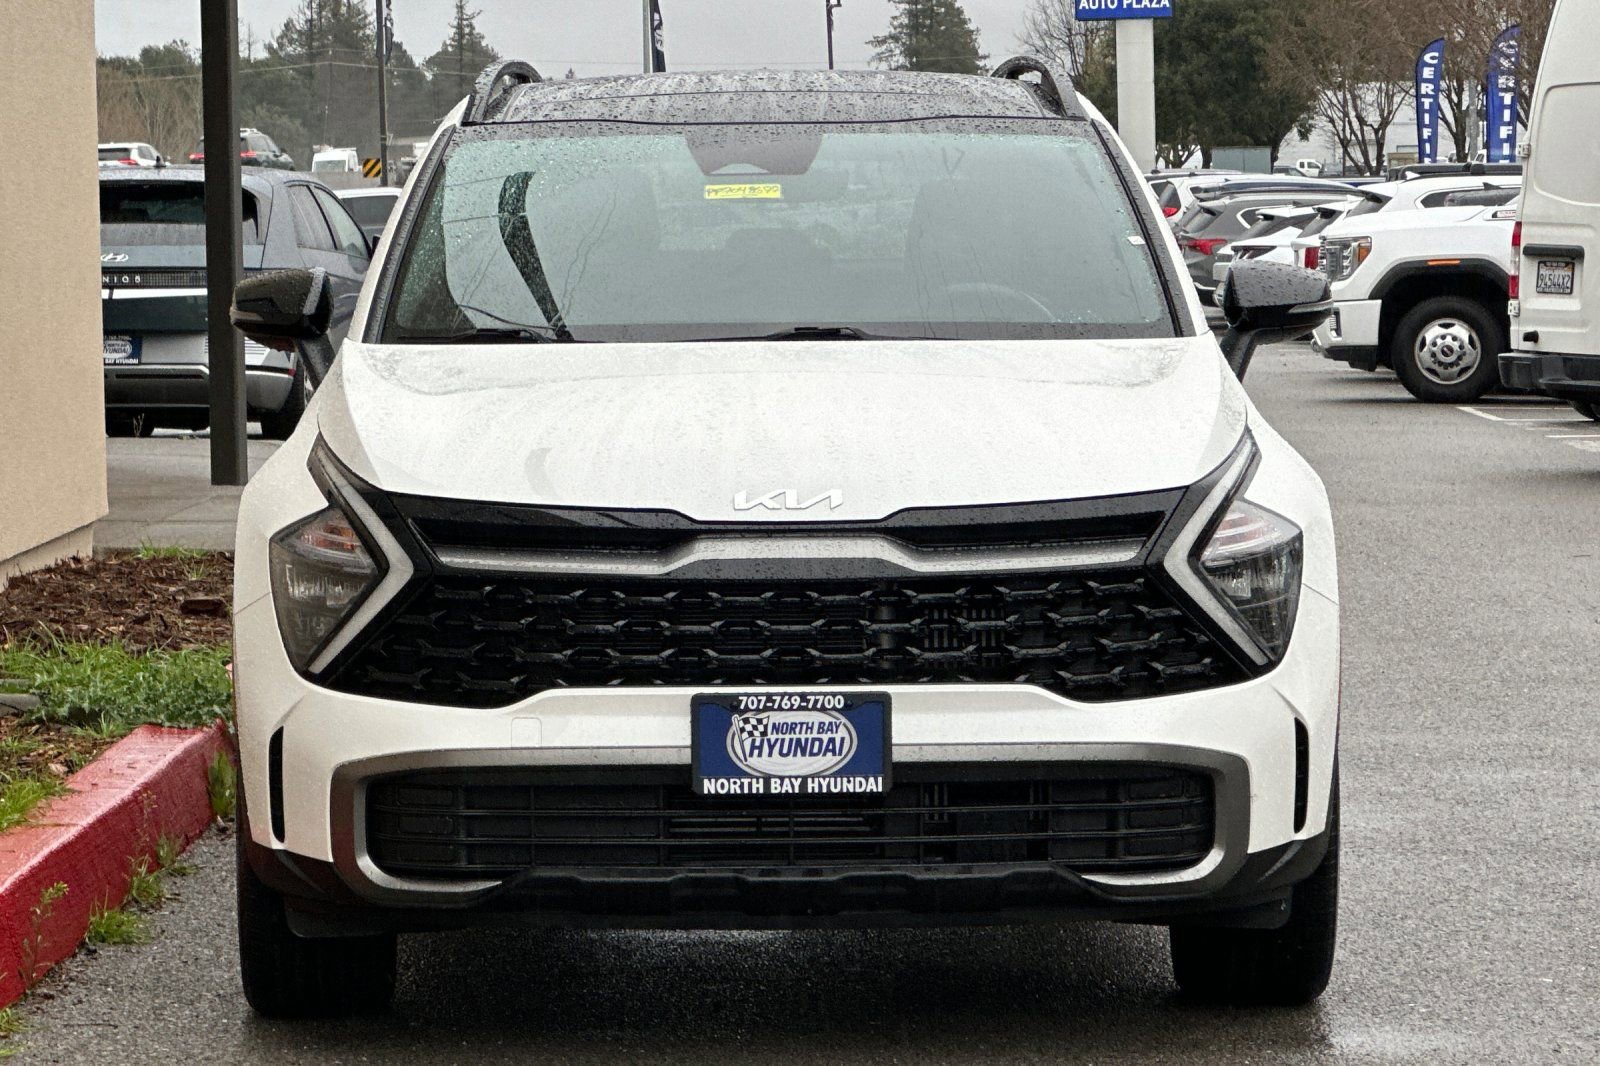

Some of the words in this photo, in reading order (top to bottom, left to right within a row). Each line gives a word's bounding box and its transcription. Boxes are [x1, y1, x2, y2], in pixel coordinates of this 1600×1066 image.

[1079, 0, 1118, 9] AUTO
[1122, 0, 1170, 8] PLAZA
[738, 695, 844, 710] 707-769-7700
[770, 721, 814, 736] NORTH
[816, 720, 843, 735] BAY
[748, 736, 846, 758] HYUNDAI
[703, 778, 764, 795] NORTH
[770, 777, 802, 794] BAY
[807, 776, 883, 793] HYUNDAI
